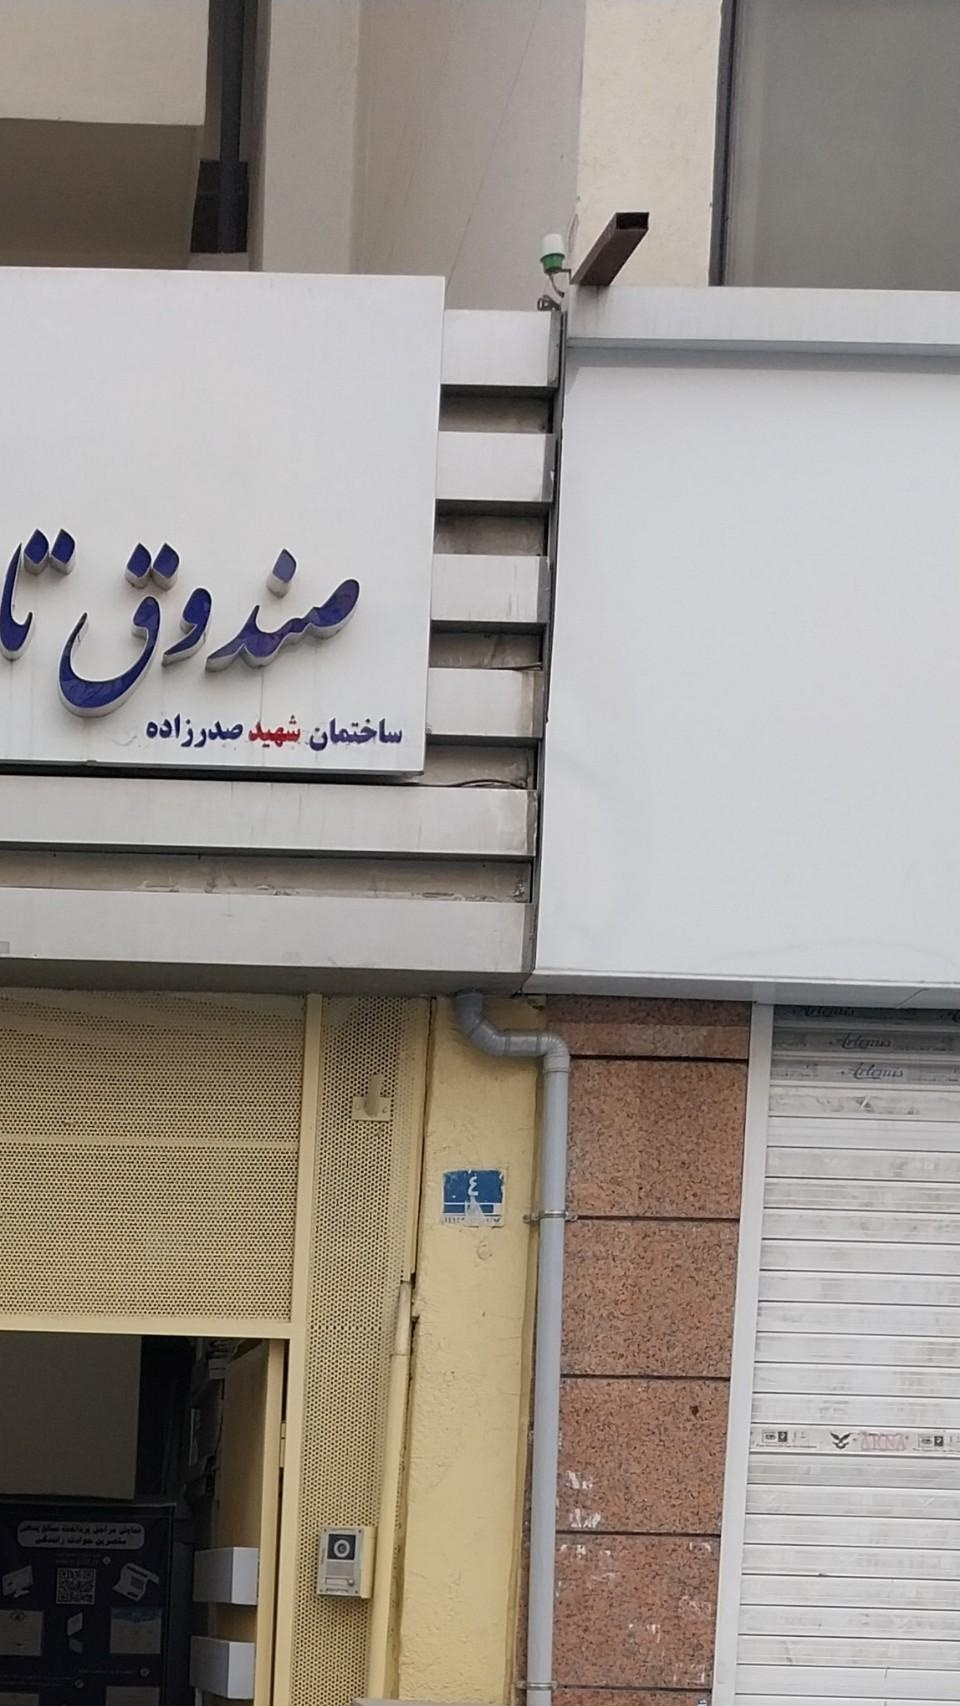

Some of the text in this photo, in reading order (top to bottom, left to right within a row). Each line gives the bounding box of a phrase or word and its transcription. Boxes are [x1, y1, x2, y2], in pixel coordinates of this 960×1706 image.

[58, 543, 361, 717] صندوق
[146, 713, 402, 751] ساختمان شهید صدرزاده
